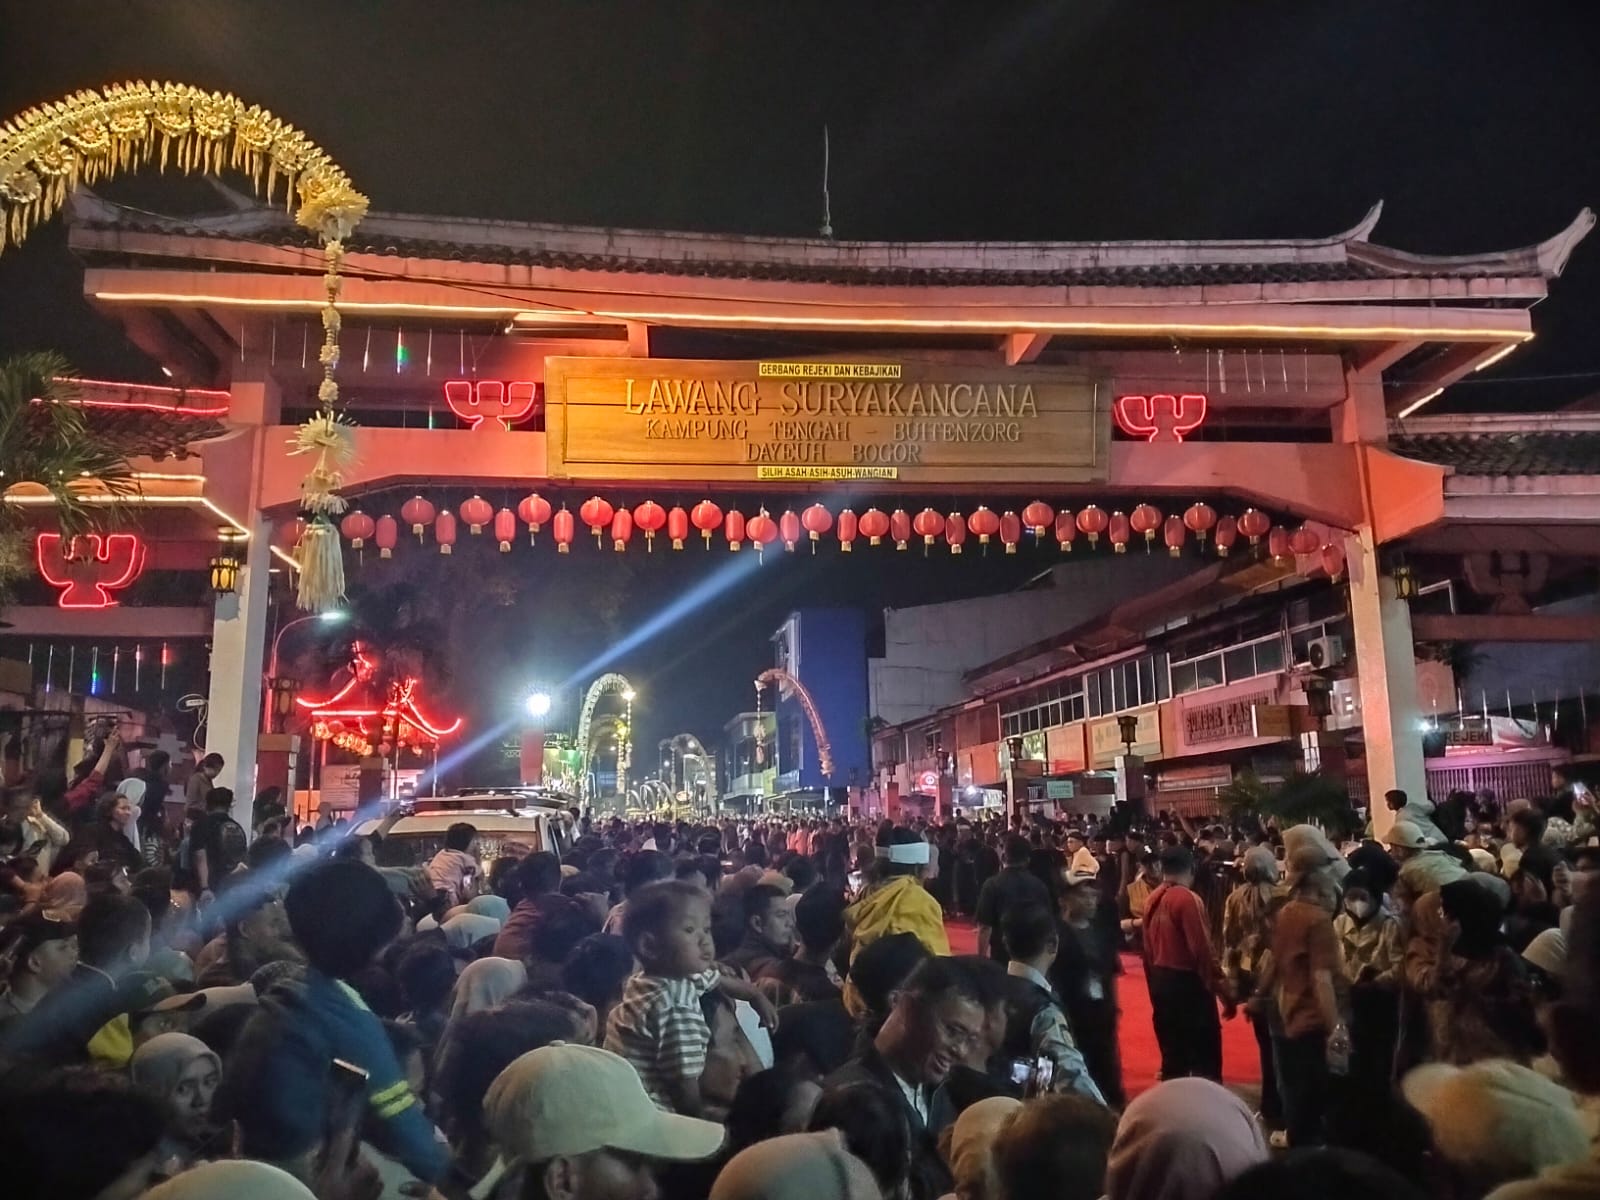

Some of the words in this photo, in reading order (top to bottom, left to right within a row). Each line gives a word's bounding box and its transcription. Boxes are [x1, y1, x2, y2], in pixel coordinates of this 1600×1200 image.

[761, 364, 800, 375] GERBANG
[802, 365, 832, 376] REJEKI
[834, 365, 851, 376] DAN
[854, 365, 899, 377] KEBAJIKAN
[624, 378, 761, 416] LAWANG
[780, 380, 1038, 418] SURYAKANCANA
[645, 418, 748, 440] KAMPUNG
[769, 420, 850, 441] TENGAH
[893, 421, 1021, 442] BUITENZORG
[747, 442, 826, 463] DAYEUH
[852, 443, 921, 464] BOGOR
[761, 467, 783, 477] SILIH
